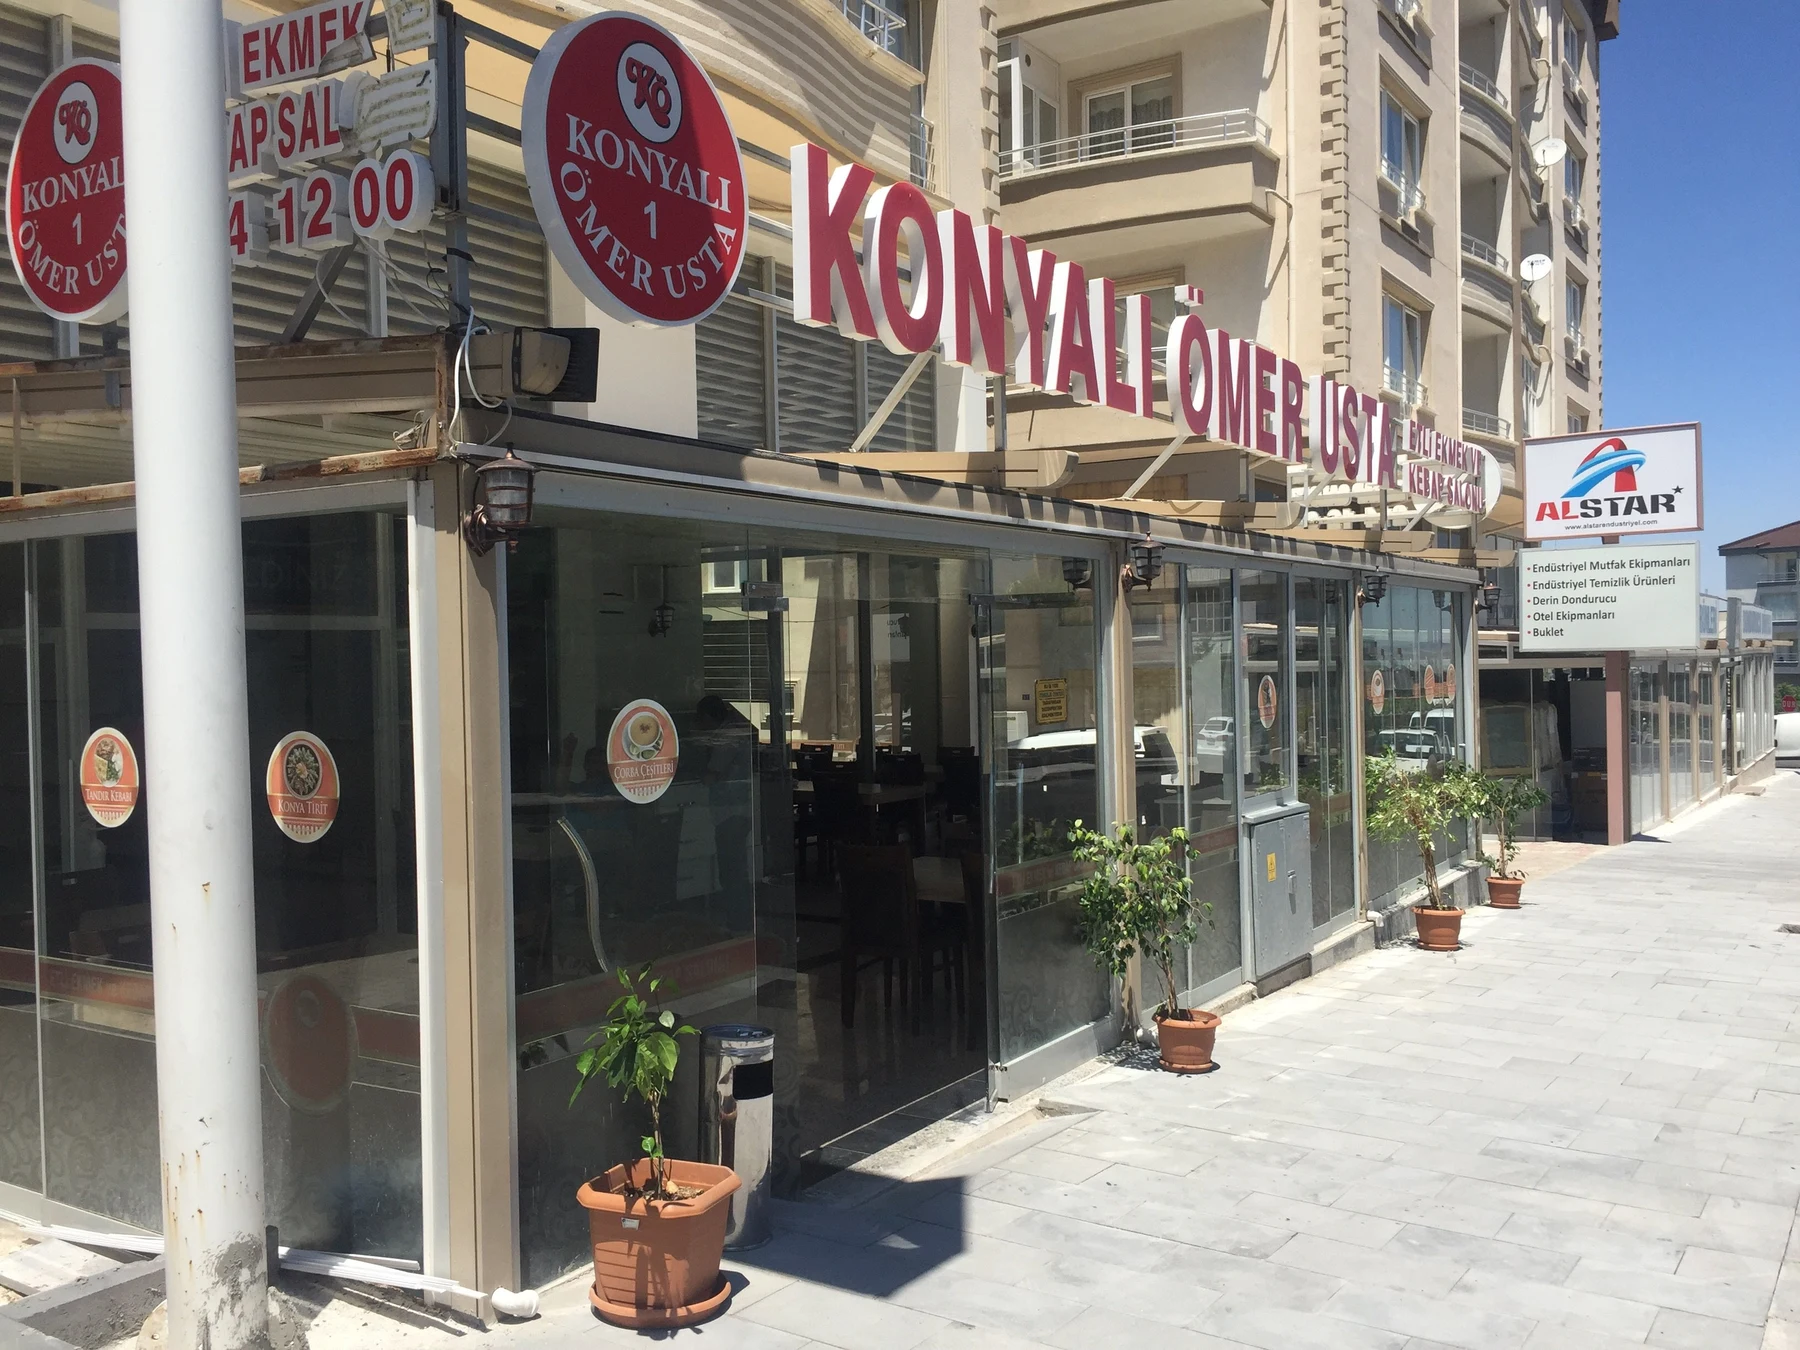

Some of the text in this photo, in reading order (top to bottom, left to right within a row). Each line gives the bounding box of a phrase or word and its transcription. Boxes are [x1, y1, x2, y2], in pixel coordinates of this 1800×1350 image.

[566, 113, 732, 214] KONYALI
[22, 156, 125, 214] KONYAL
[278, 177, 332, 244] 12
[353, 158, 413, 228] 00
[72, 213, 82, 245] 1
[560, 161, 737, 299] ÖMER USTA
[643, 201, 657, 240] 1
[18, 213, 127, 295] ÖMER UST
[791, 142, 1395, 489] KONYALI ÖMER USTA
[1535, 493, 1676, 522] ALSTAR
[1565, 519, 1658, 531] www.alstarendustriyel.com
[1532, 557, 1691, 575] Endüstriyel Mutfak Ekipmanları
[1532, 574, 1676, 592] Endüstriyel Temizlik Ürünleri
[1532, 594, 1617, 605] Derin Dondurucu
[1532, 609, 1615, 622] Otel Ekipmanları
[1532, 627, 1564, 637] Buklet
[278, 799, 305, 813] KONYA
